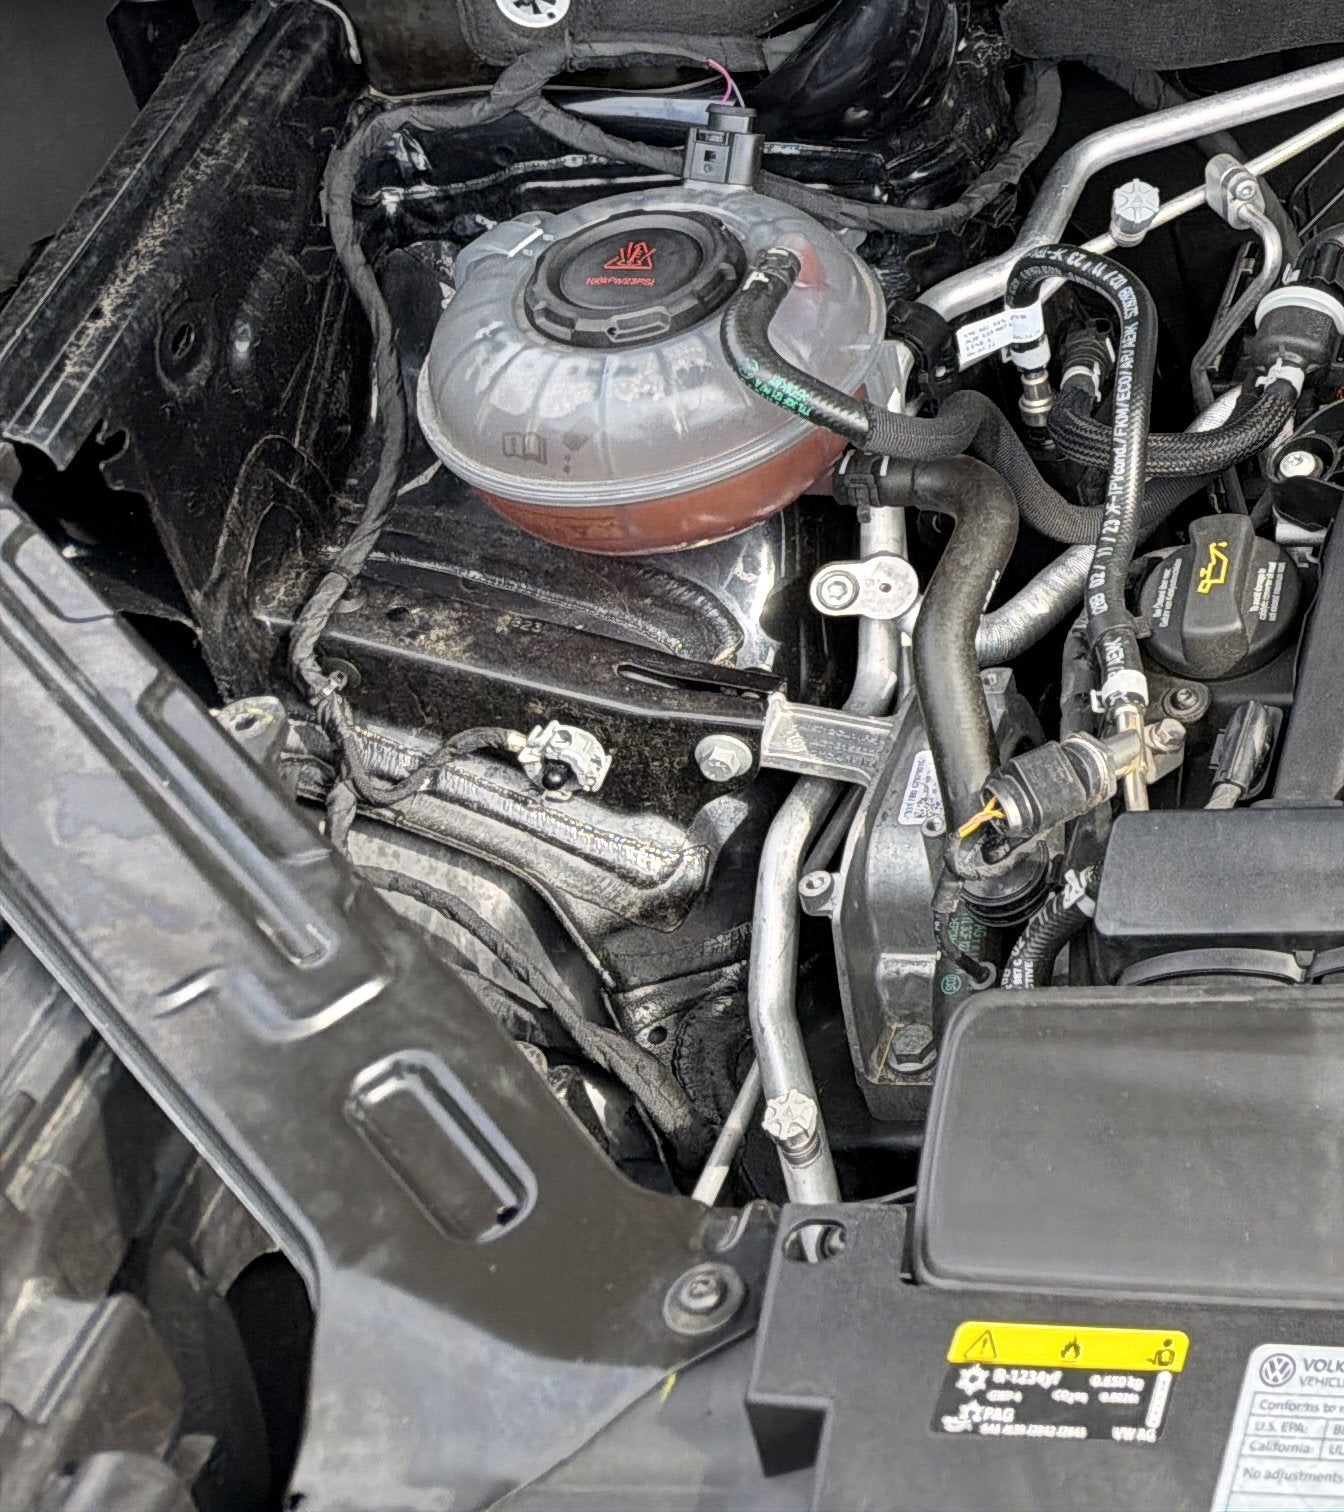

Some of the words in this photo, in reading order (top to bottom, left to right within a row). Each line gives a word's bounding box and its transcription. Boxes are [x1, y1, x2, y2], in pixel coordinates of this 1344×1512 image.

[983, 1406, 1015, 1422] PAG
[1259, 1399, 1320, 1412] Conforms
[1323, 1402, 1336, 1414] to
[1242, 1467, 1262, 1479] No
[1264, 1469, 1343, 1487] adjustments
